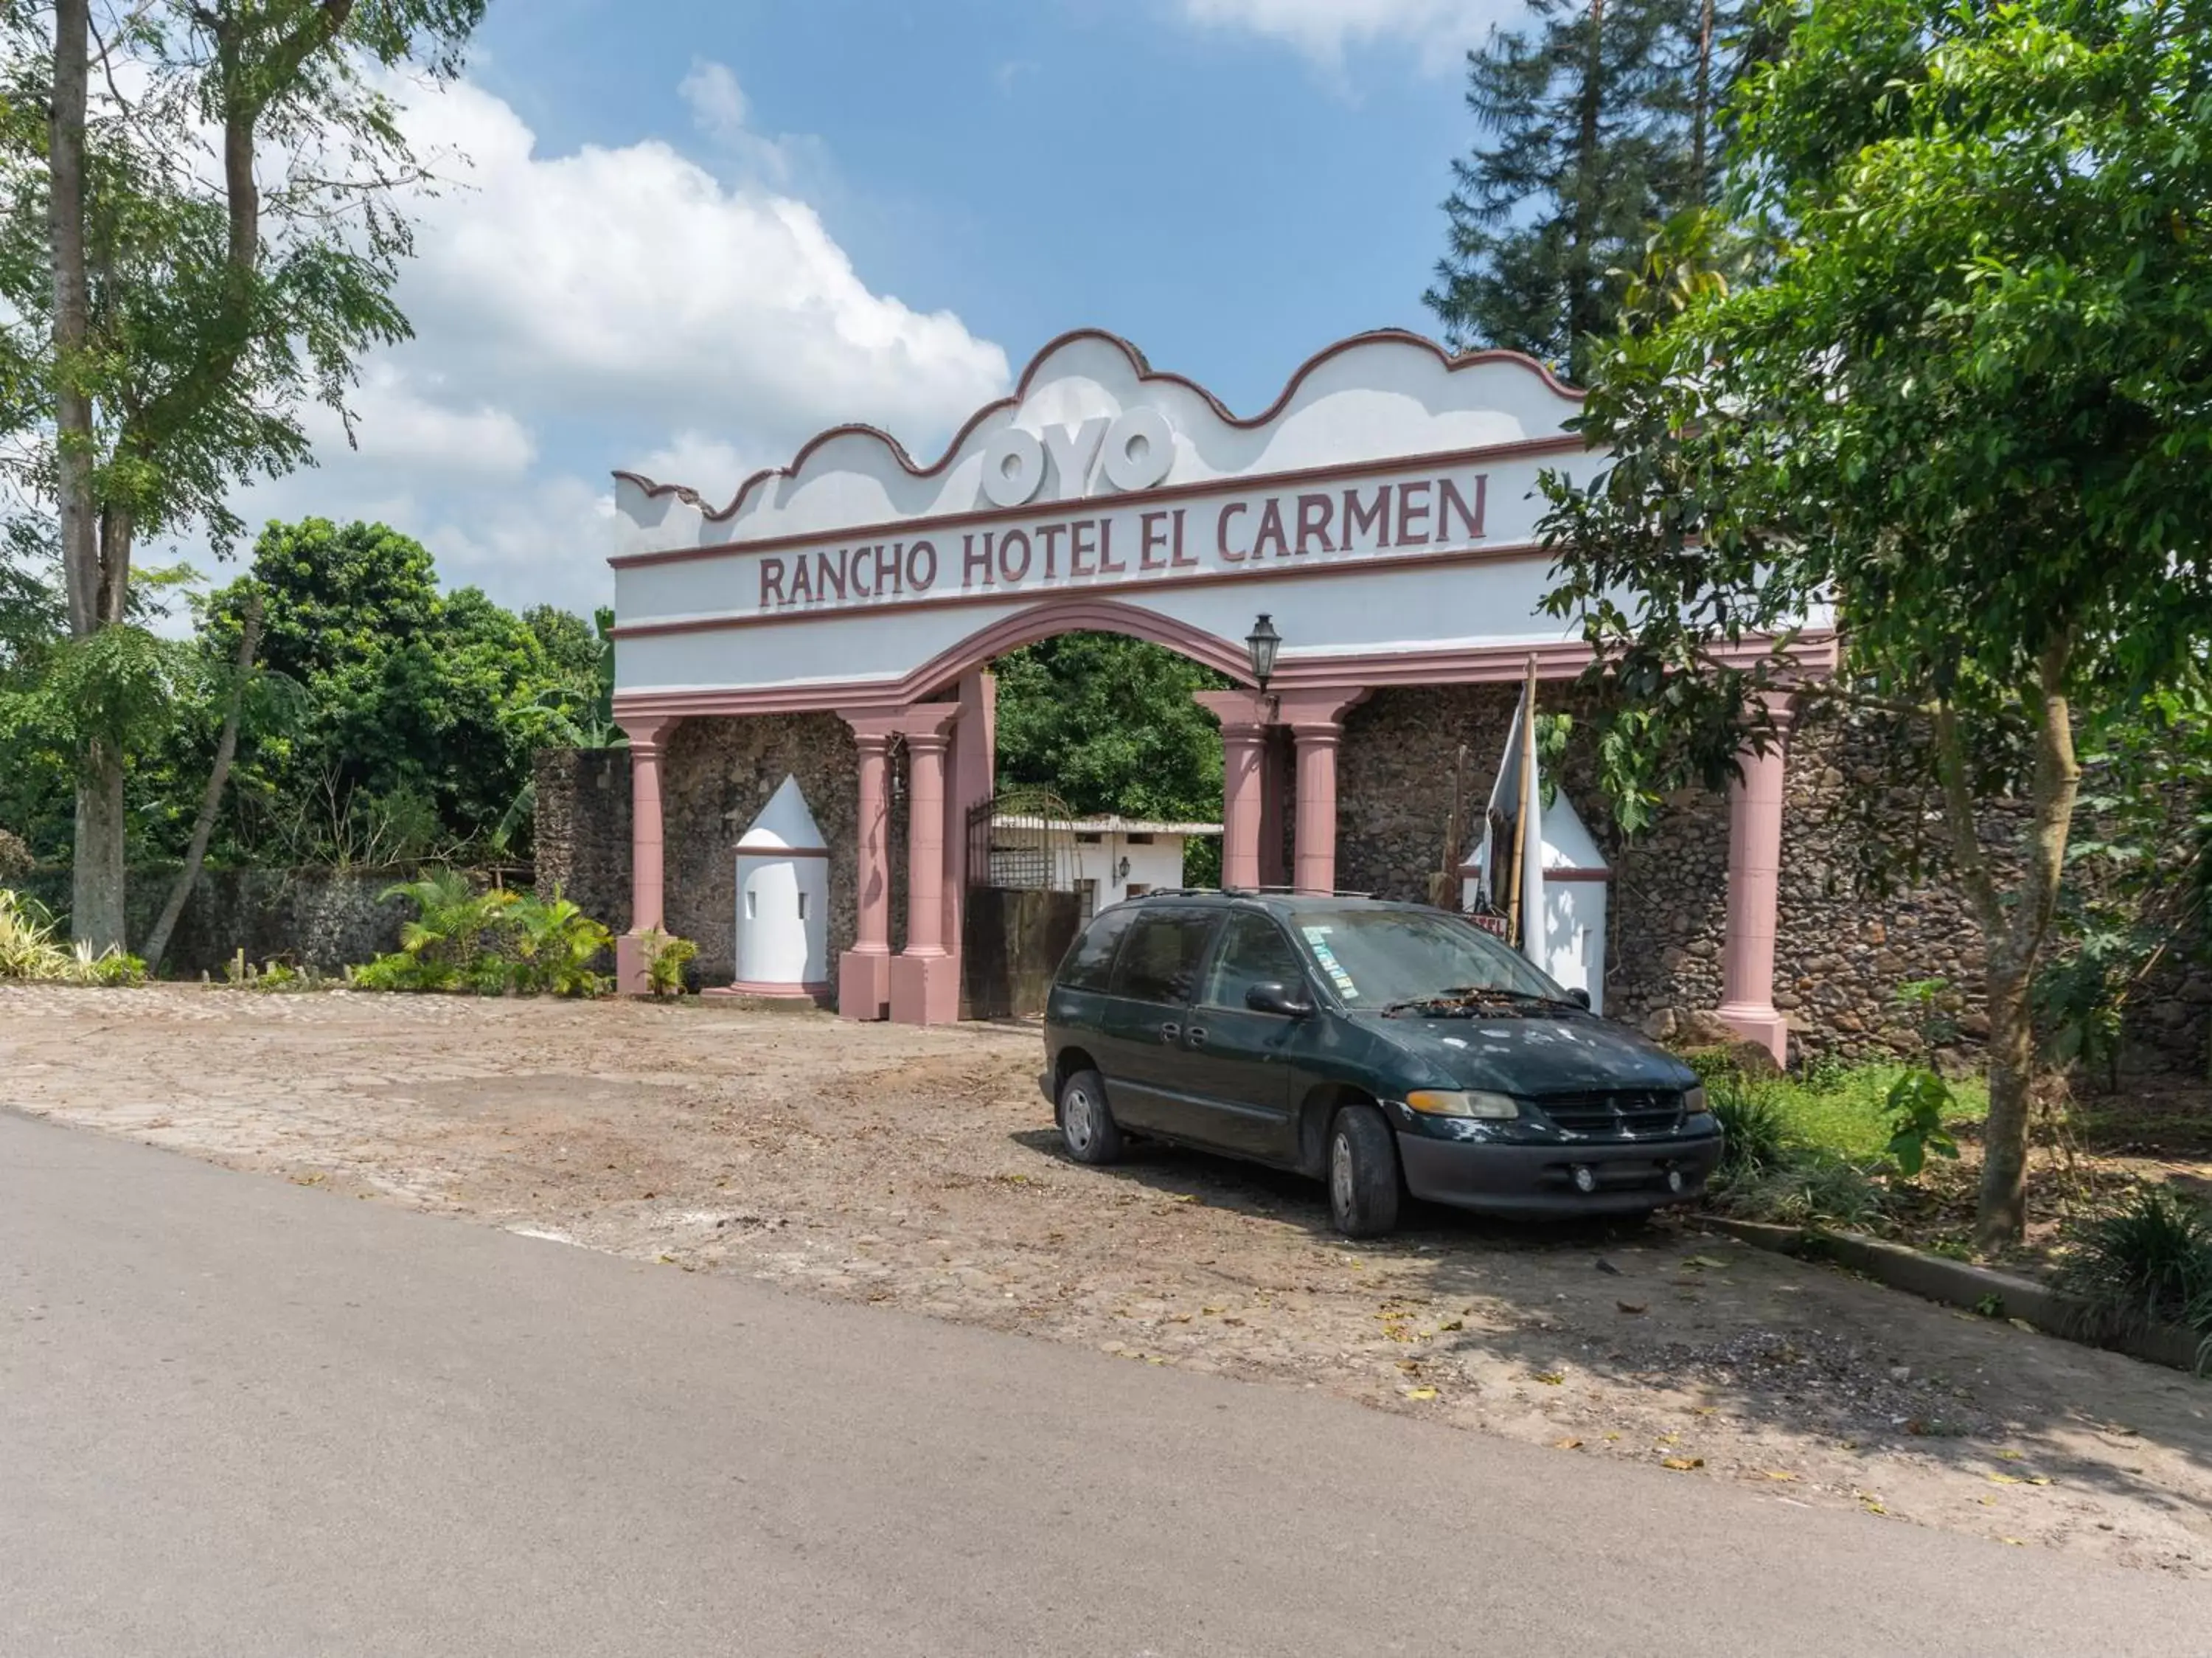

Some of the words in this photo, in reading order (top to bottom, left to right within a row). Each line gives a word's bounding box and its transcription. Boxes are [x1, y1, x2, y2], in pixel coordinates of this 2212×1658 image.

[981, 406, 1176, 507] OYO
[759, 540, 937, 608] RANCHO
[962, 518, 1126, 587] HOTEL
[1139, 509, 1200, 571] EL
[1217, 474, 1488, 562] CARMEN
